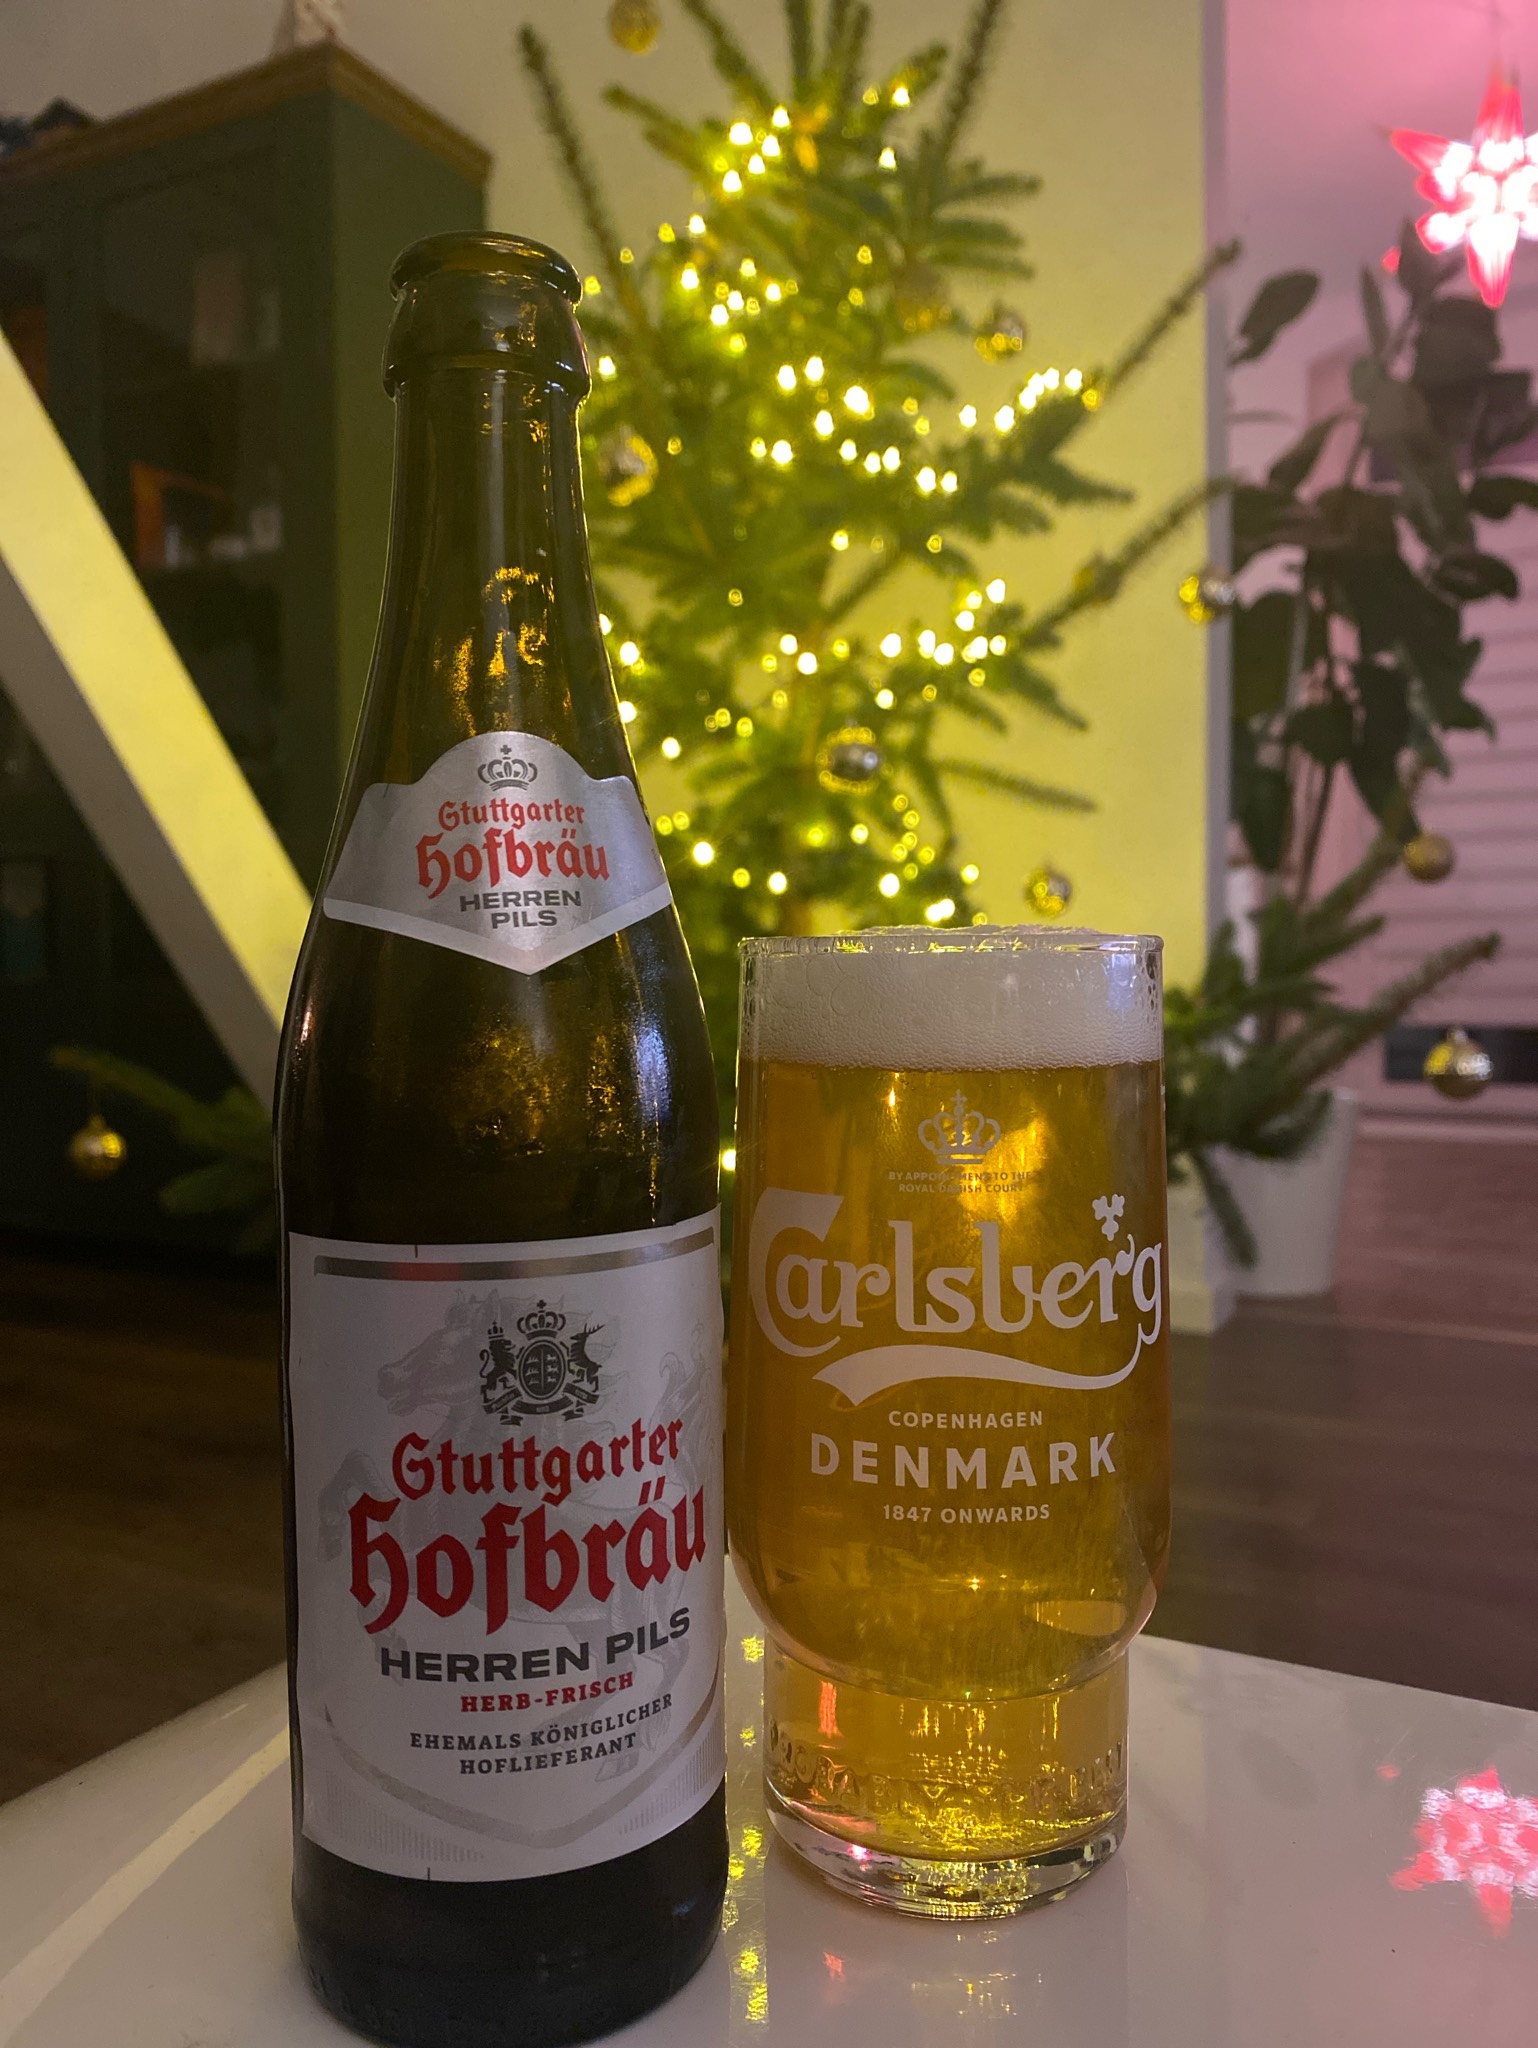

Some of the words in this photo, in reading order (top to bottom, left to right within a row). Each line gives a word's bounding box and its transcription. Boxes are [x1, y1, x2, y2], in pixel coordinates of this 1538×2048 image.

[438, 798, 585, 830] Stuttgarter
[459, 890, 582, 912] HERREN
[491, 910, 557, 929] PILS
[889, 1171, 902, 1181] BY
[994, 1172, 1009, 1181] TO
[898, 1183, 935, 1193] ROYAL
[748, 1187, 1162, 1357] Carlsberg
[888, 1410, 1044, 1428] COPENHAGEN
[392, 1417, 684, 1506] Stuttgarter
[811, 1432, 1116, 1490] DENMARK
[883, 1504, 932, 1522] 1847
[940, 1504, 1051, 1524] ONWARDS
[380, 1641, 590, 1682] HERREN
[606, 1607, 691, 1665] PILS
[460, 1671, 635, 1713] HERB-FRISCH
[410, 1732, 522, 1751] EHEMALS
[530, 1693, 673, 1747] KÖNIGLICHER
[460, 1732, 637, 1775] HOFLIEFERANT
